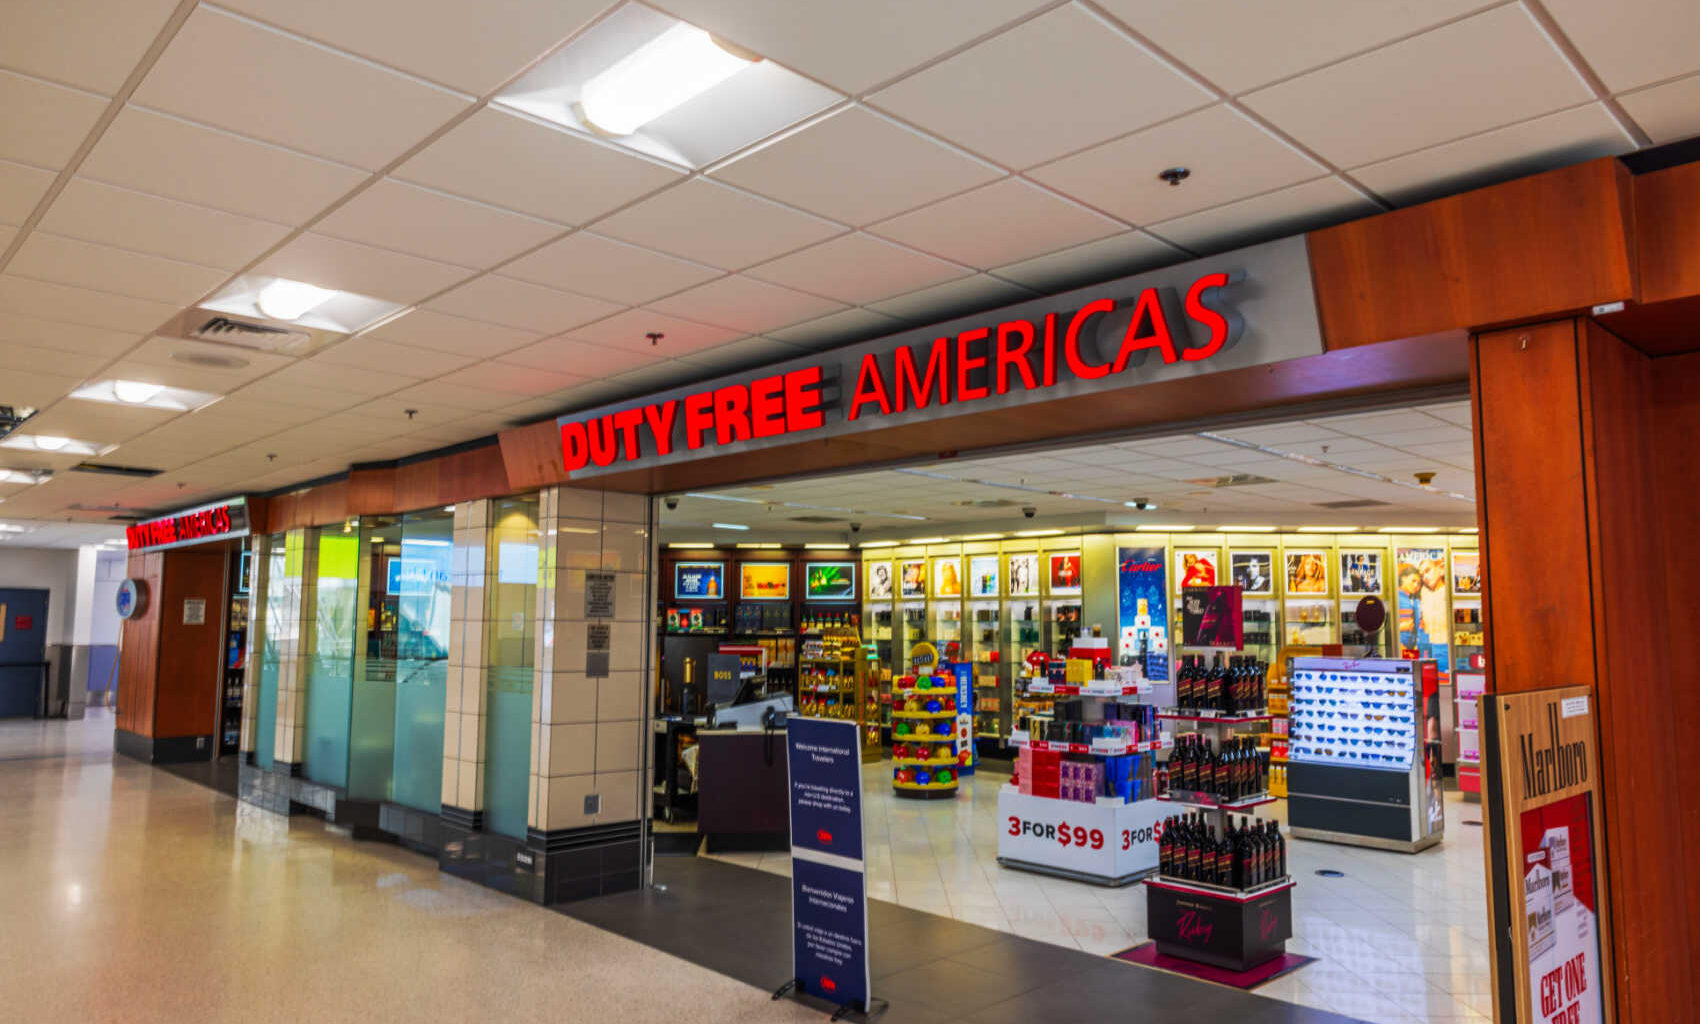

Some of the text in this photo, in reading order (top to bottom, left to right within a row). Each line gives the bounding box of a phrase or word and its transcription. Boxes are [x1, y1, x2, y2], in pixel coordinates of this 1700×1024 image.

[561, 273, 1227, 472] DUTY FREE AMERICAS
[178, 505, 230, 540] AMERICAS
[1121, 559, 1163, 573] Cartier
[1520, 702, 1588, 799] Marlboro
[1541, 966, 1562, 1018] GET
[1564, 952, 1586, 1001] ONE
